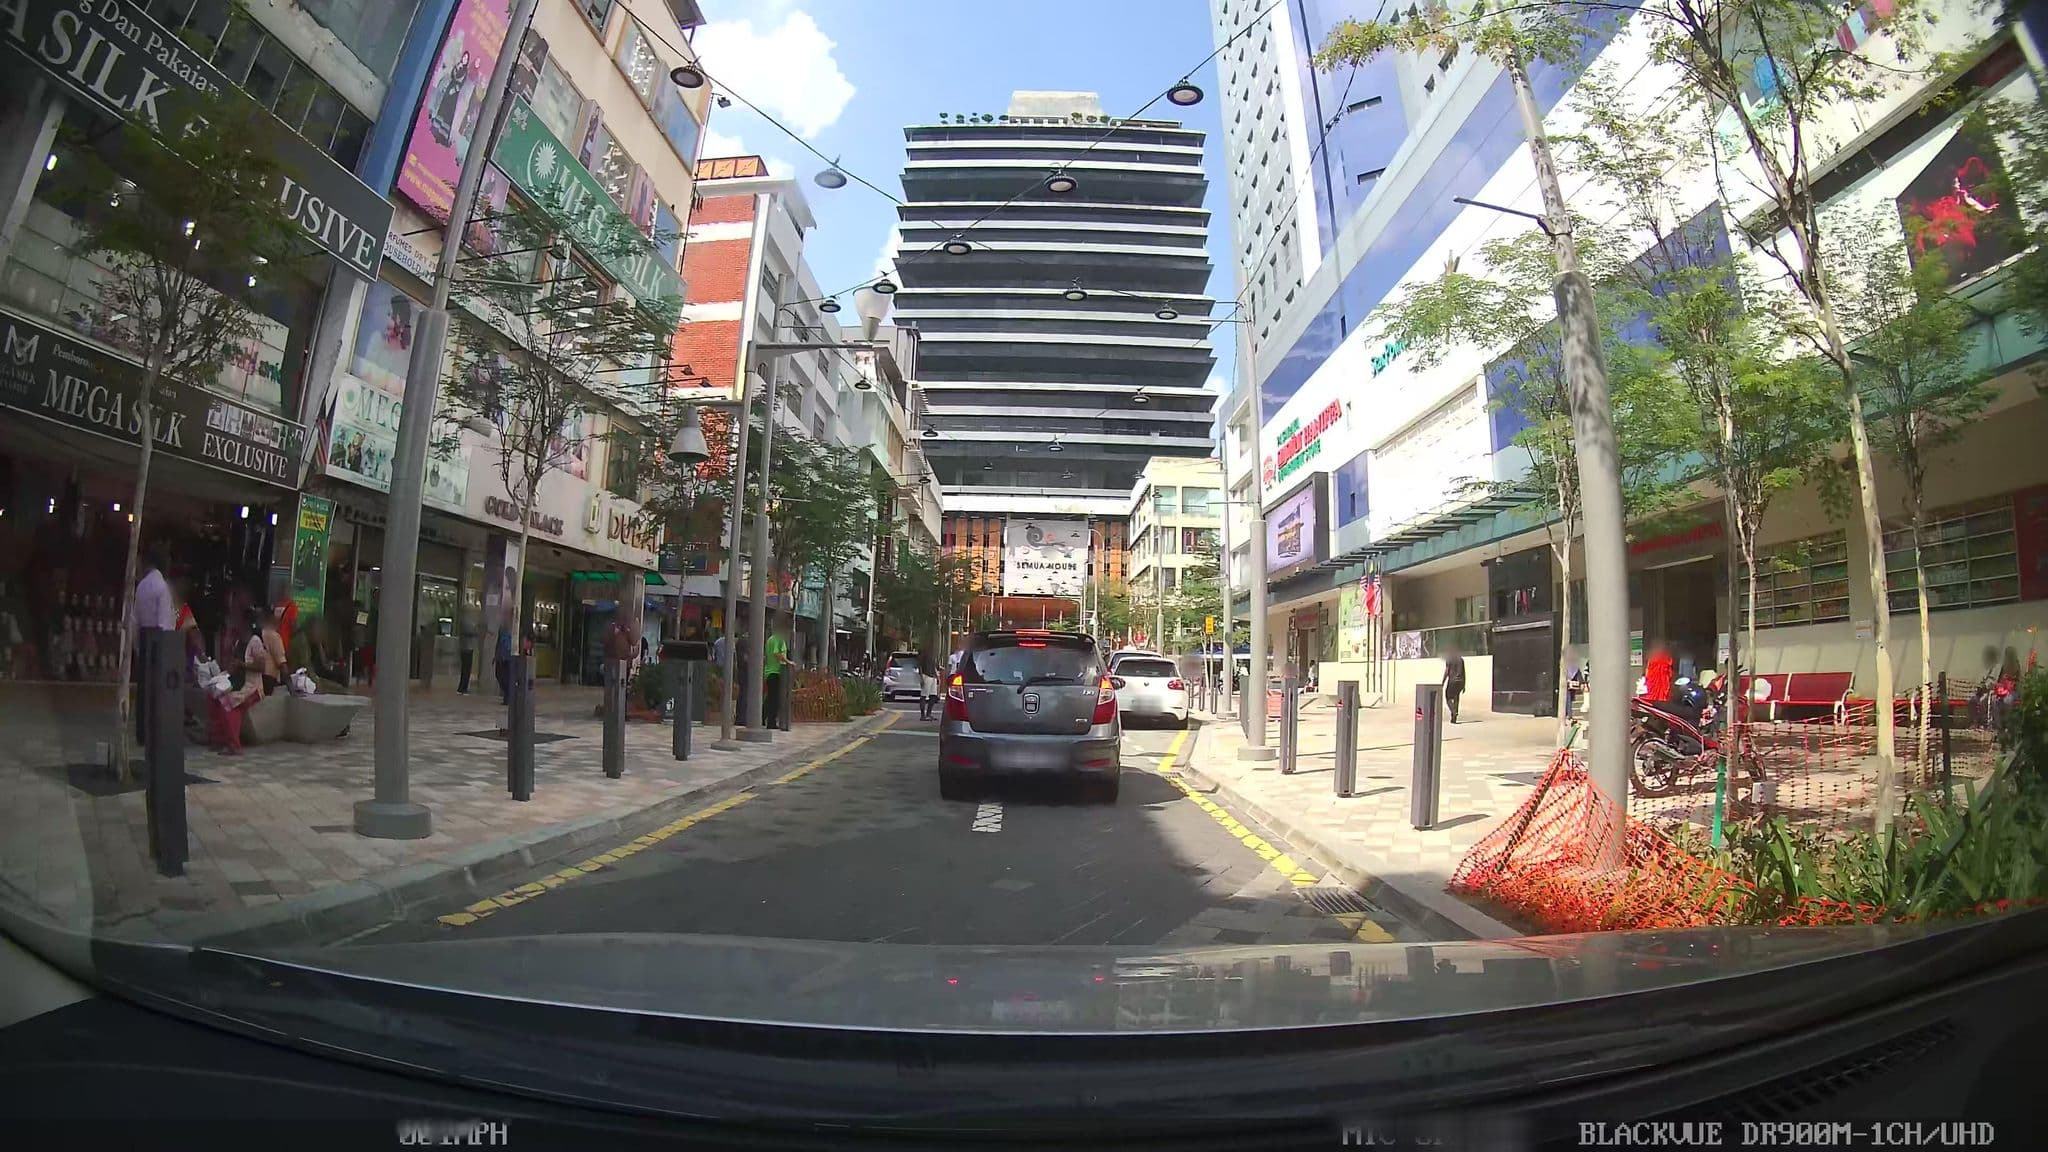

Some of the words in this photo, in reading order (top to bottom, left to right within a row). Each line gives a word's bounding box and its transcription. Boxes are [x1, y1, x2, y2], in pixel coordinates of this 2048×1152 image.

[98, 0, 142, 45] Dan
[38, 9, 175, 134] SILK
[40, 368, 124, 431] MEGA
[127, 399, 188, 449] SLK
[201, 432, 289, 479] EXCLUSIVE
